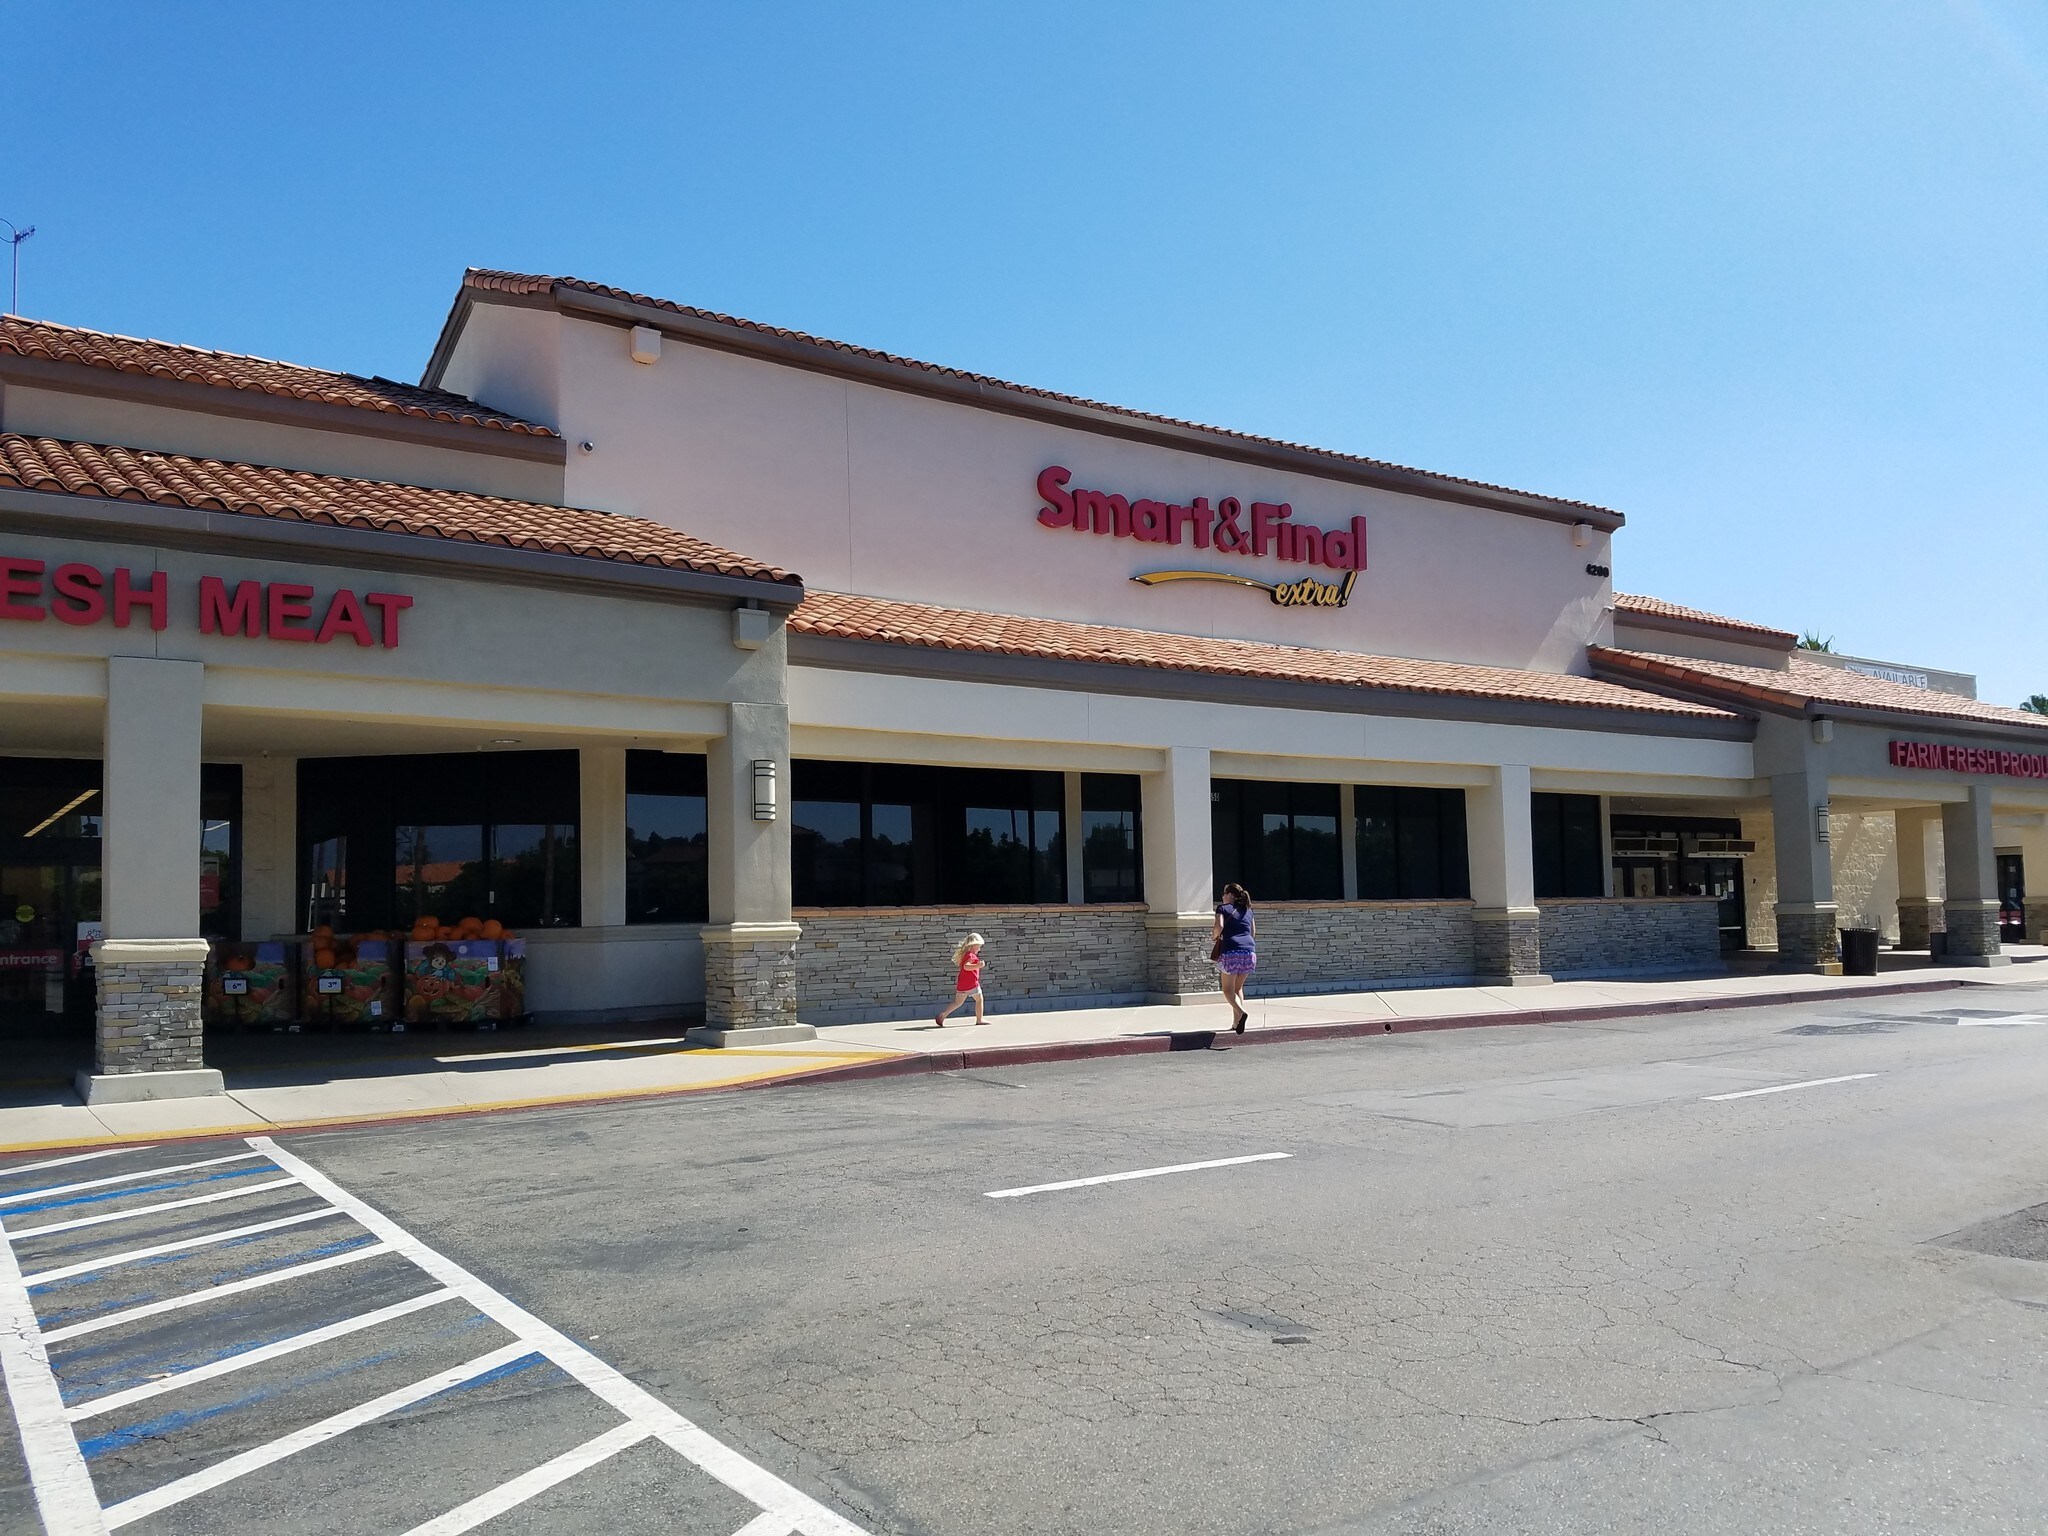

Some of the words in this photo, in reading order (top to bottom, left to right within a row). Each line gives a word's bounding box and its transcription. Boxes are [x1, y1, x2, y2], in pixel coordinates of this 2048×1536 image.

[1037, 465, 1367, 571] Smart&Final
[0, 556, 168, 631] ESH
[199, 576, 413, 649] MEAT
[1271, 569, 1358, 608] extra!
[1889, 740, 1943, 769] FARM
[1947, 745, 1998, 775] FRESH
[2000, 751, 2048, 780] PRODU
